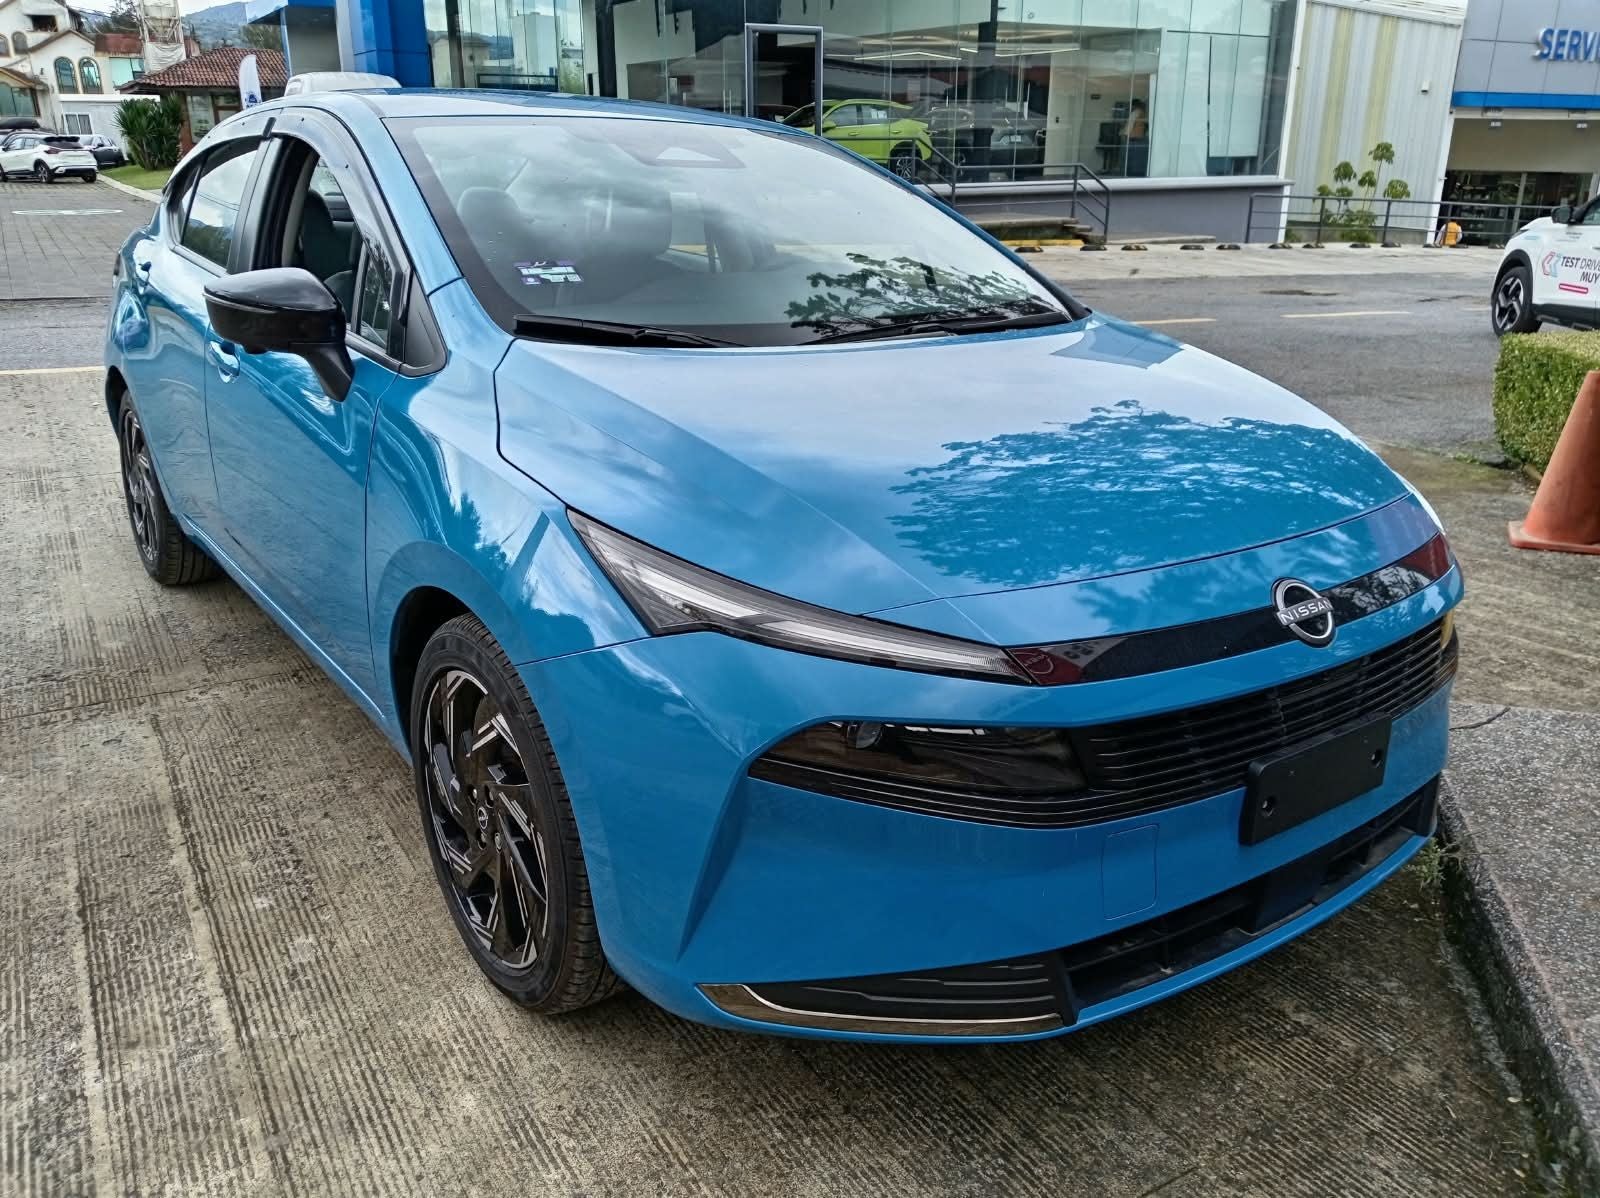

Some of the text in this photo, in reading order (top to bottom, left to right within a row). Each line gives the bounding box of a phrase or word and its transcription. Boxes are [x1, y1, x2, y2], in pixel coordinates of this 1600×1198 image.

[1561, 256, 1580, 268] TEST
[1580, 271, 1600, 284] MUY
[1280, 599, 1333, 624] NISSAN
